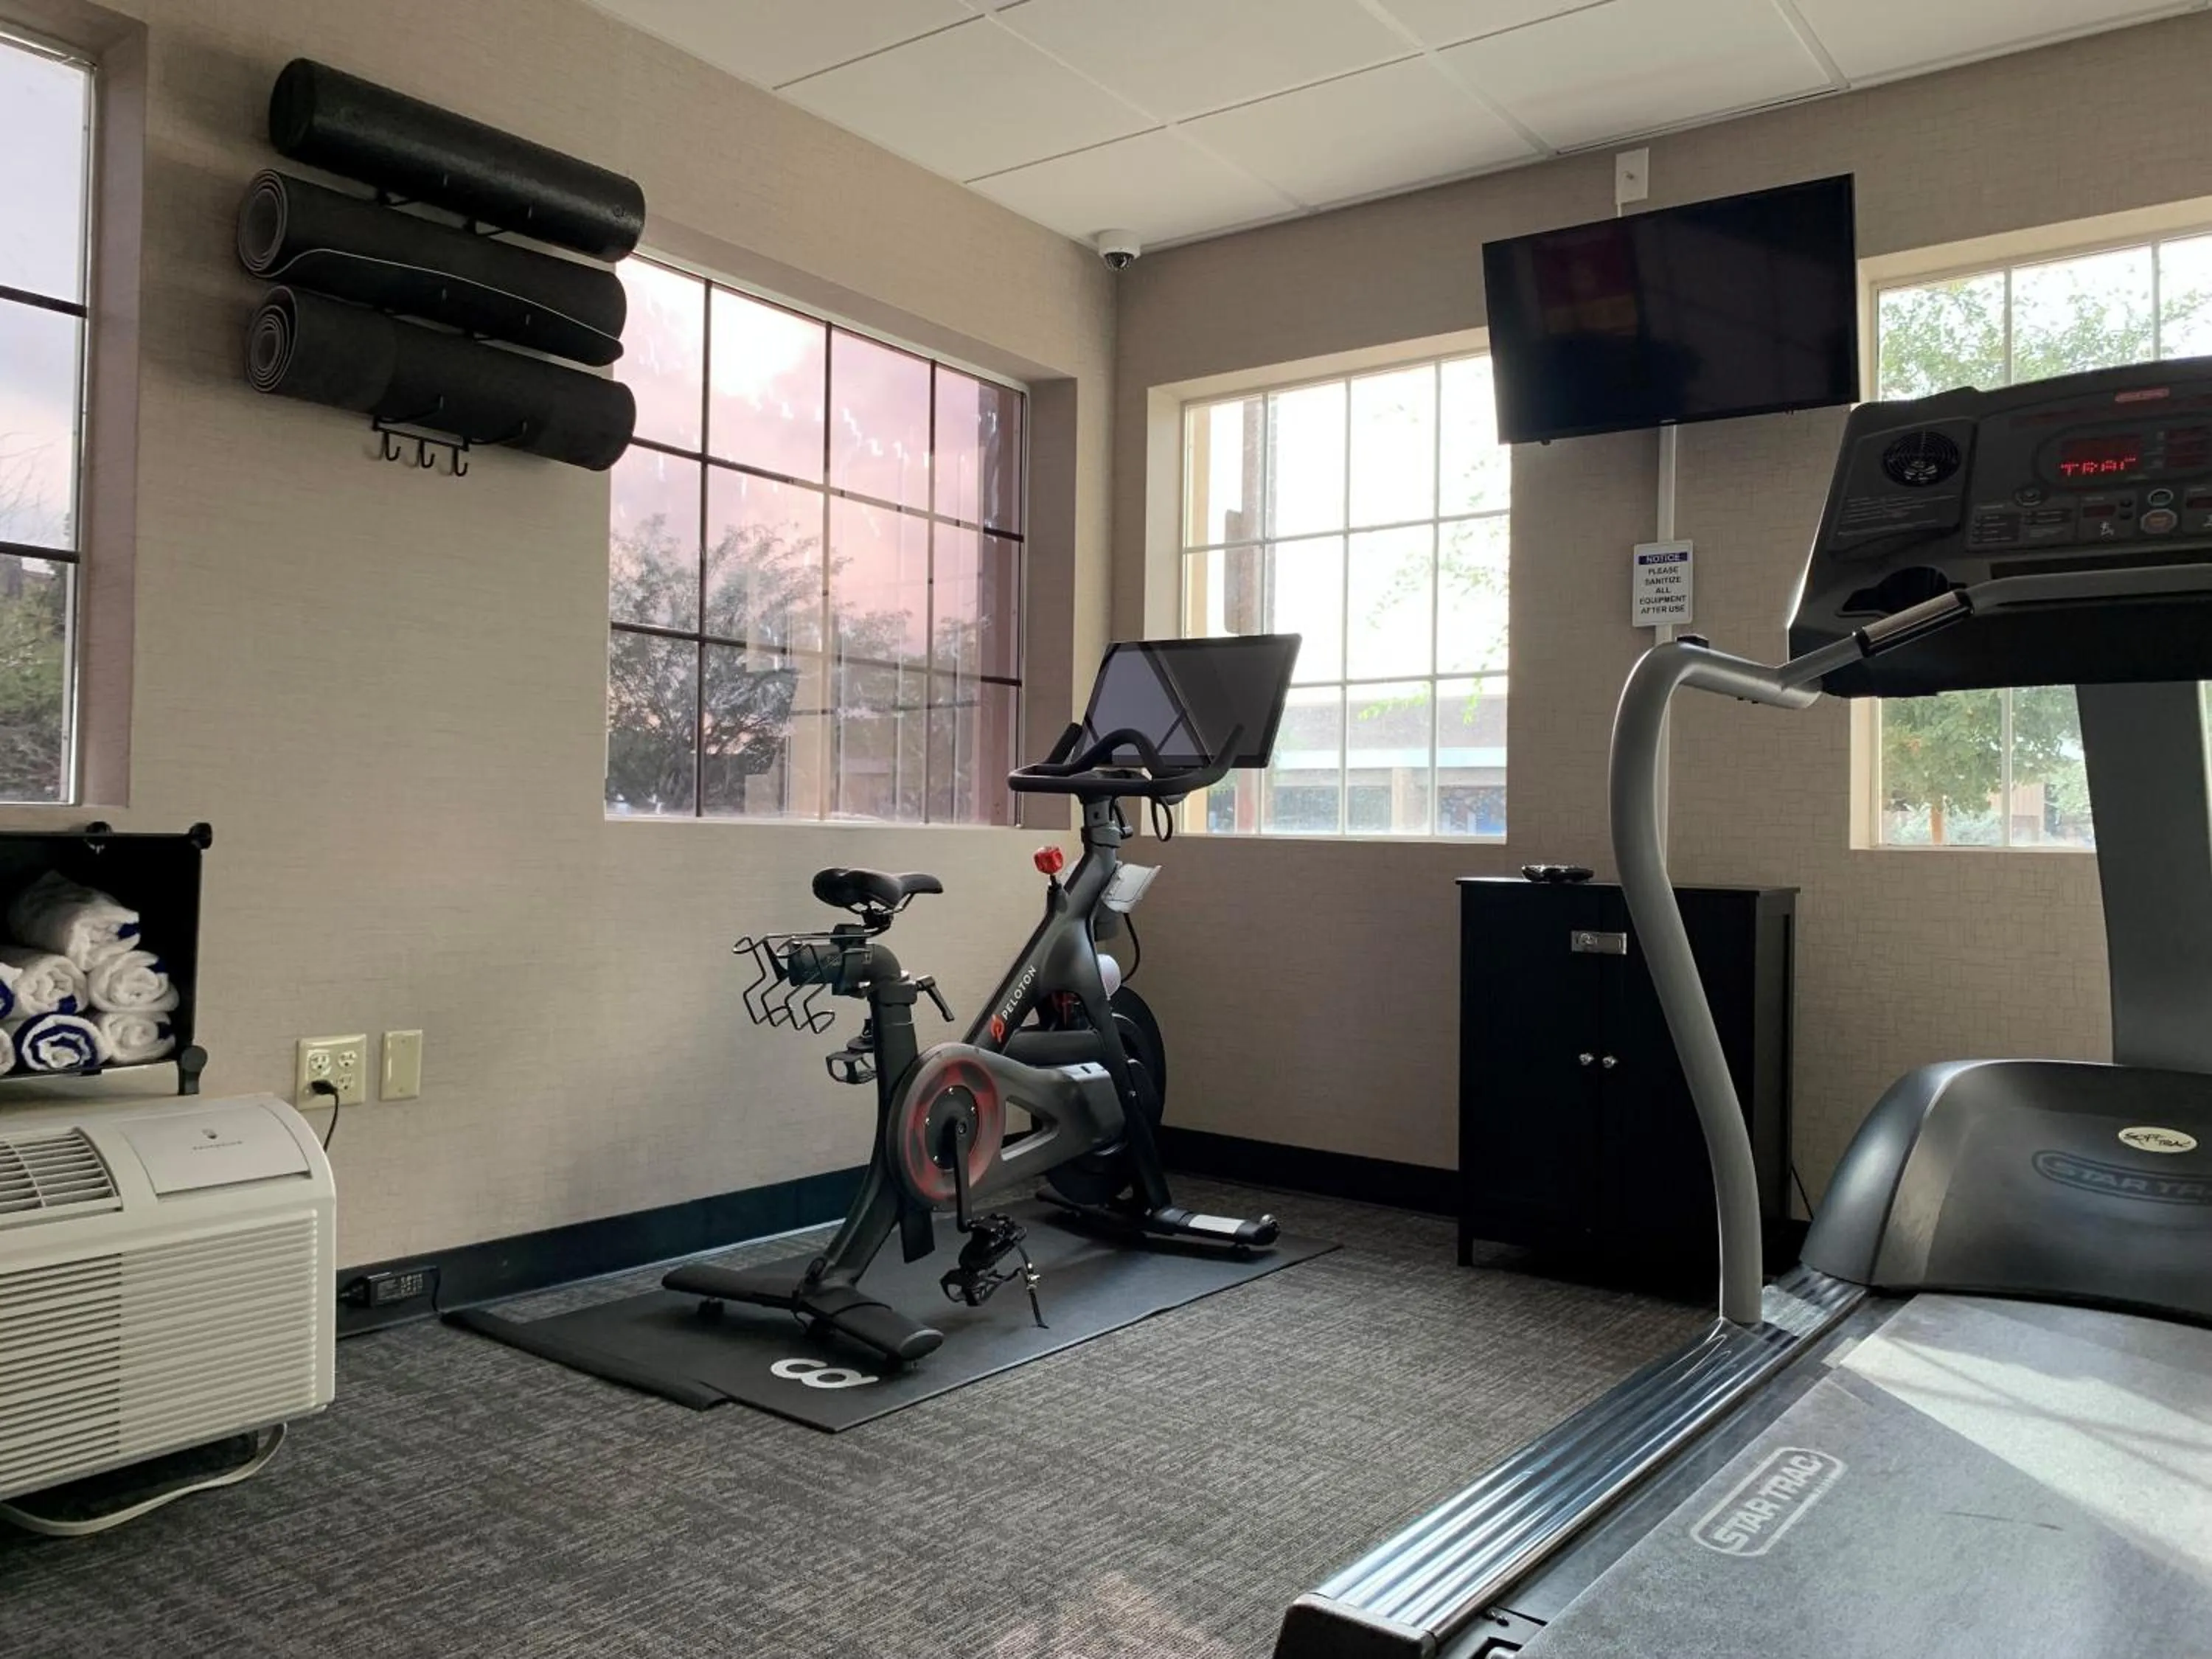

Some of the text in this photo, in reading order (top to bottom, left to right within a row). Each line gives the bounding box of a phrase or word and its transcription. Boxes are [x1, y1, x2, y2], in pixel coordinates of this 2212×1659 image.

[1646, 554, 1680, 563] NOTICE
[1648, 566, 1679, 576] PLEASE
[1645, 576, 1681, 585] SANITIZE
[1639, 595, 1687, 605] EQUIPMENT
[1641, 605, 1685, 614] AFTER USE
[1001, 964, 1037, 1020] PELOTON
